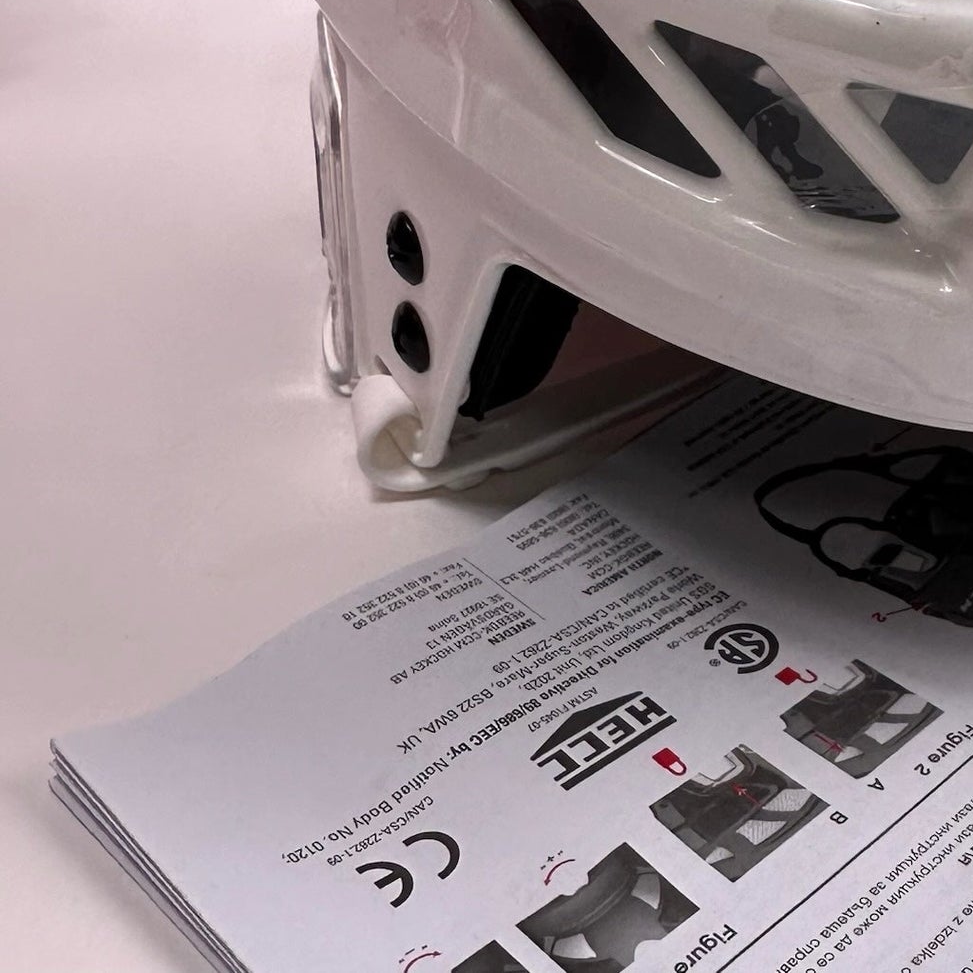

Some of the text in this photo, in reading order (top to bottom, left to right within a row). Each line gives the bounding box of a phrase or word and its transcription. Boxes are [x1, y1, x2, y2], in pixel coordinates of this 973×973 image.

[709, 590, 730, 604] EC
[486, 617, 536, 646] SWEDEN
[595, 654, 618, 669] for
[537, 696, 667, 782] HECC
[913, 763, 932, 776] 2
[867, 777, 885, 791] A
[829, 810, 849, 825] B
[355, 830, 461, 908] CE
[673, 923, 738, 973] Figure
